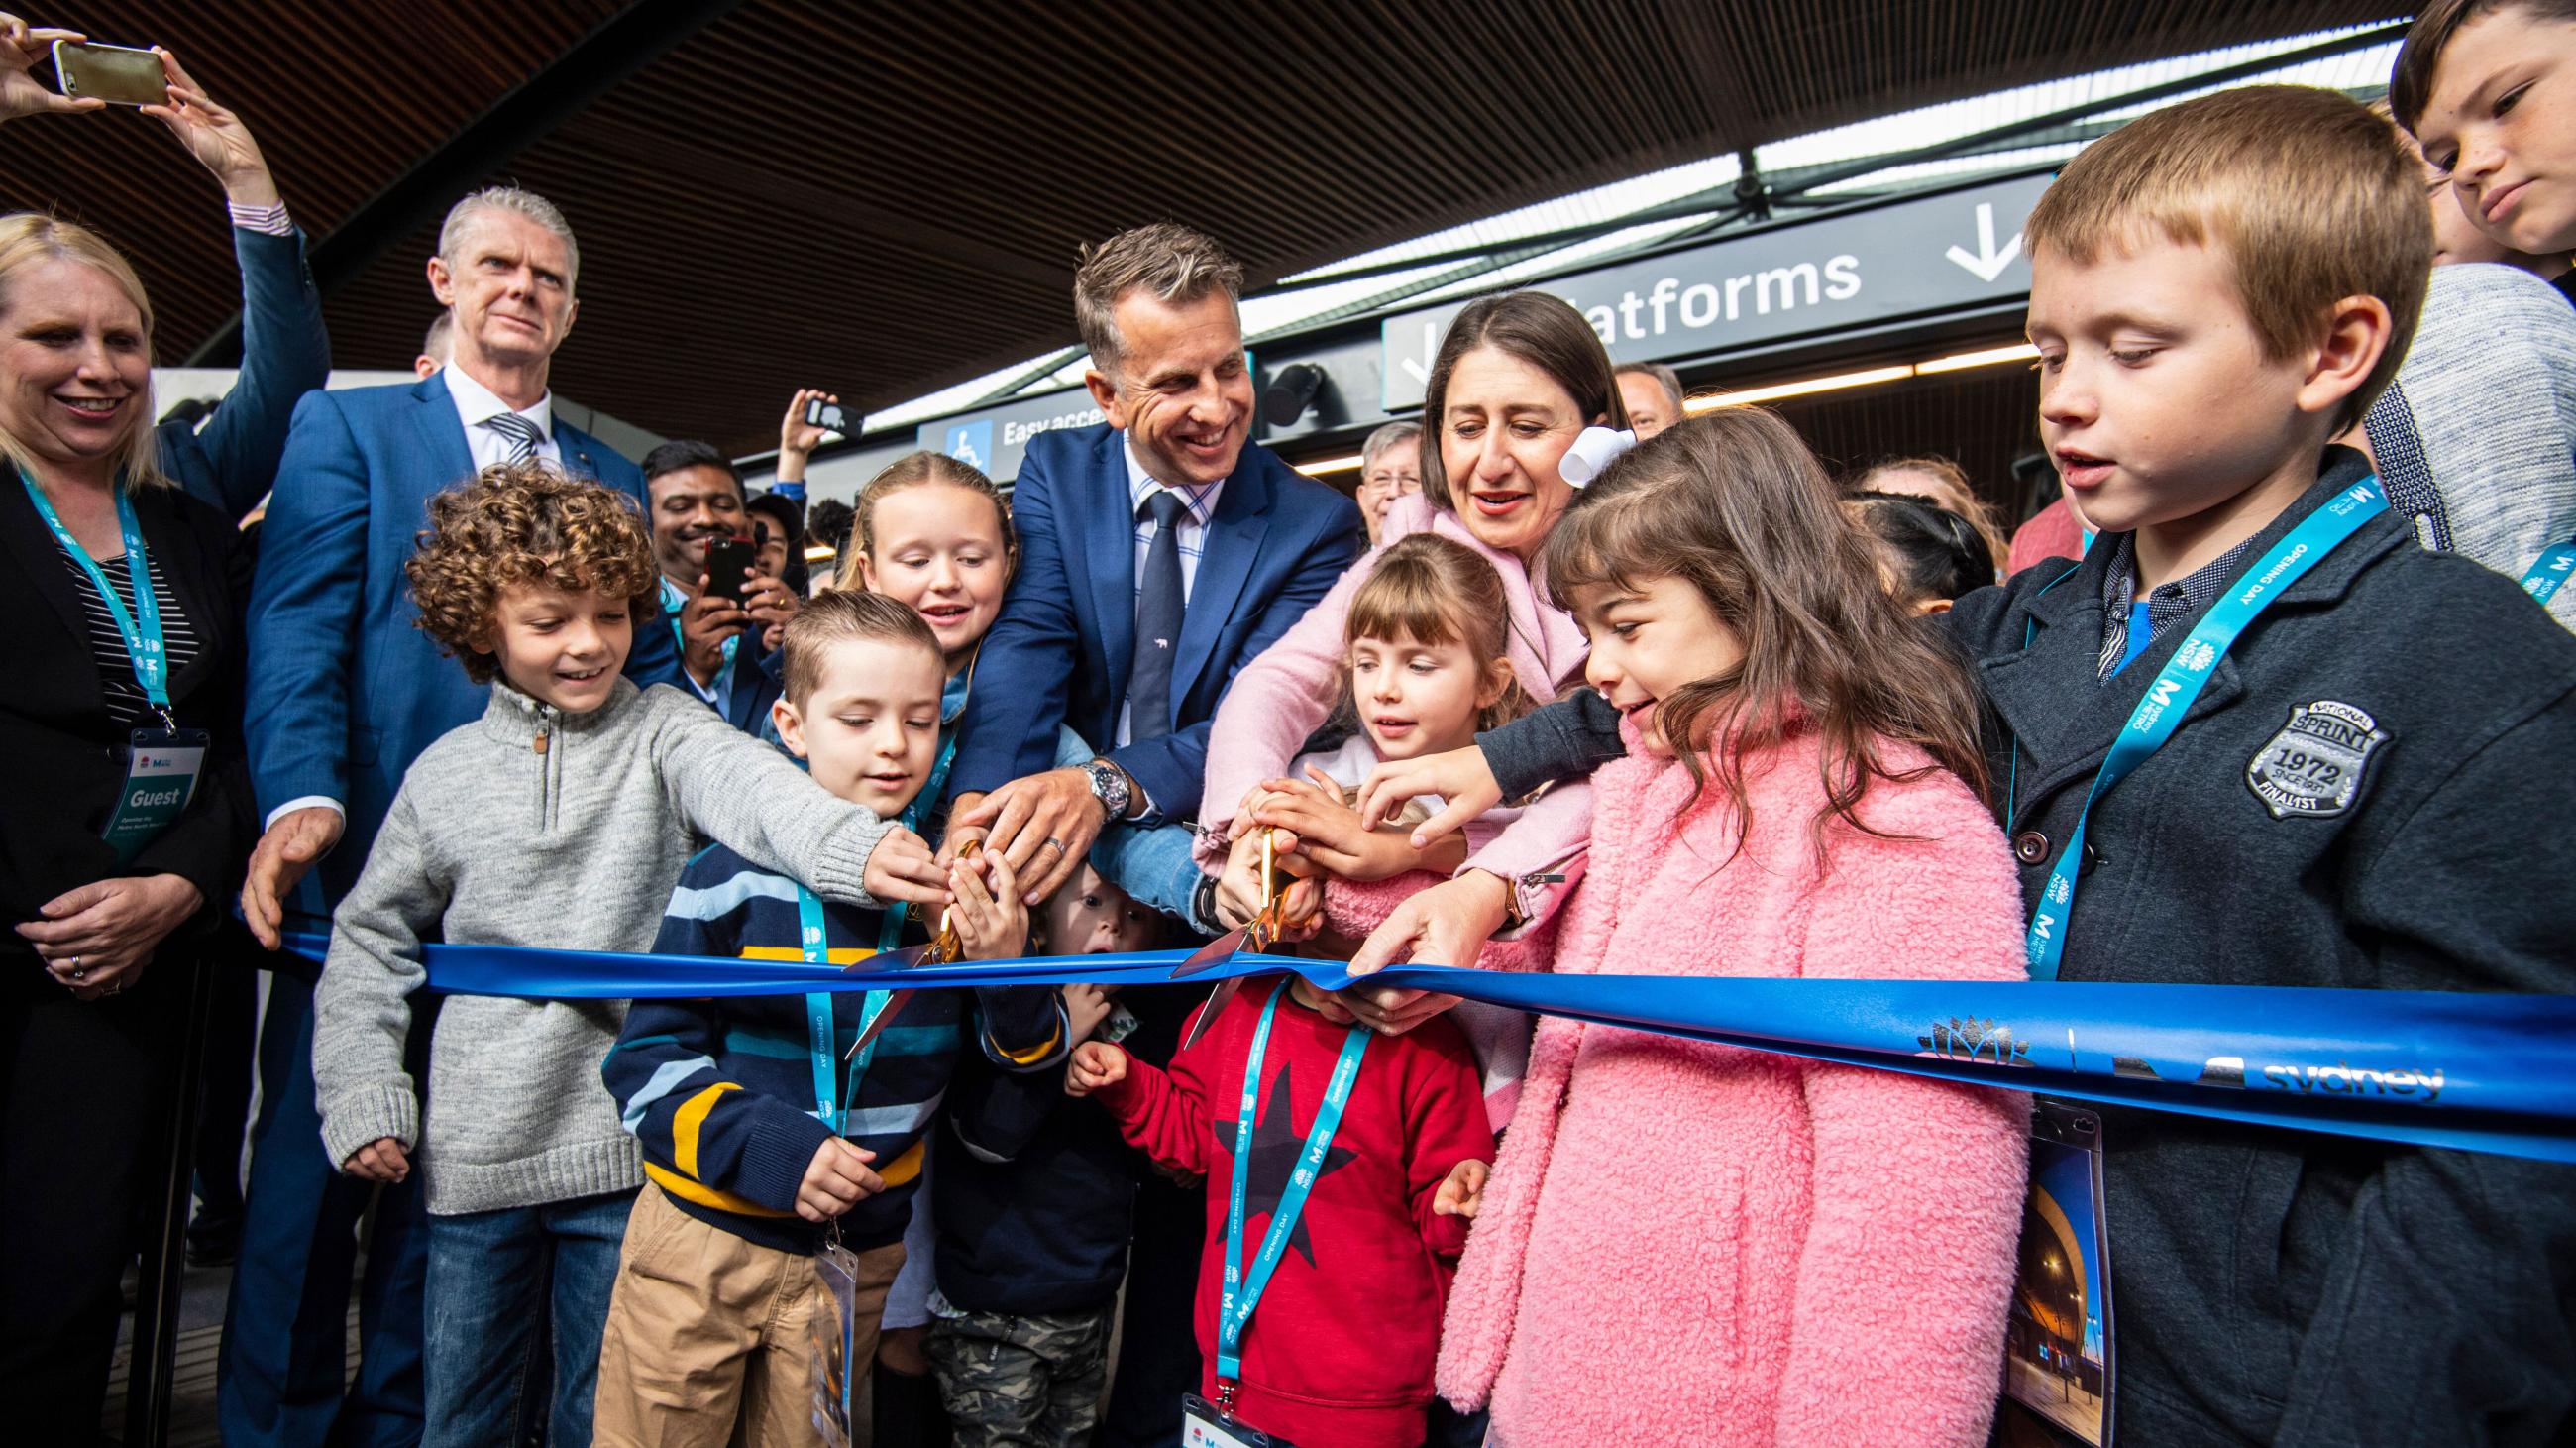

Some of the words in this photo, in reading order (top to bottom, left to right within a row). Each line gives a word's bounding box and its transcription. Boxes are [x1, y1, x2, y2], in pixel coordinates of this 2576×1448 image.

[1569, 254, 1862, 344] atforms
[2348, 486, 2376, 503] M
[2259, 543, 2308, 585] OPENING
[2549, 556, 2575, 571] M
[2240, 584, 2265, 606] DAY
[2536, 579, 2557, 597] NSW
[146, 658, 158, 671] M
[2175, 637, 2201, 668] NSW
[2149, 678, 2182, 707] M
[2132, 701, 2156, 730] METRO
[2139, 705, 2164, 734] sydney
[2313, 703, 2372, 727] NATIONAL
[2293, 715, 2375, 750] SPRINT
[2271, 768, 2305, 786] SINCE
[2273, 748, 2341, 787] 1972
[130, 788, 180, 808] Guest
[2046, 873, 2062, 901] NSW
[2034, 913, 2055, 940] M
[816, 1015, 826, 1052] OPENING
[1332, 1069, 1349, 1103] OPENING
[1343, 1055, 1354, 1071] DAY
[2263, 1059, 2445, 1102] sydney
[1238, 1120, 1248, 1135] M
[1309, 1146, 1323, 1164] M
[1302, 1171, 1314, 1189] NSW
[1264, 1228, 1283, 1262] OPENING
[1279, 1212, 1290, 1229] DAY
[1223, 1292, 1234, 1309] M
[1237, 1302, 1249, 1320] M
